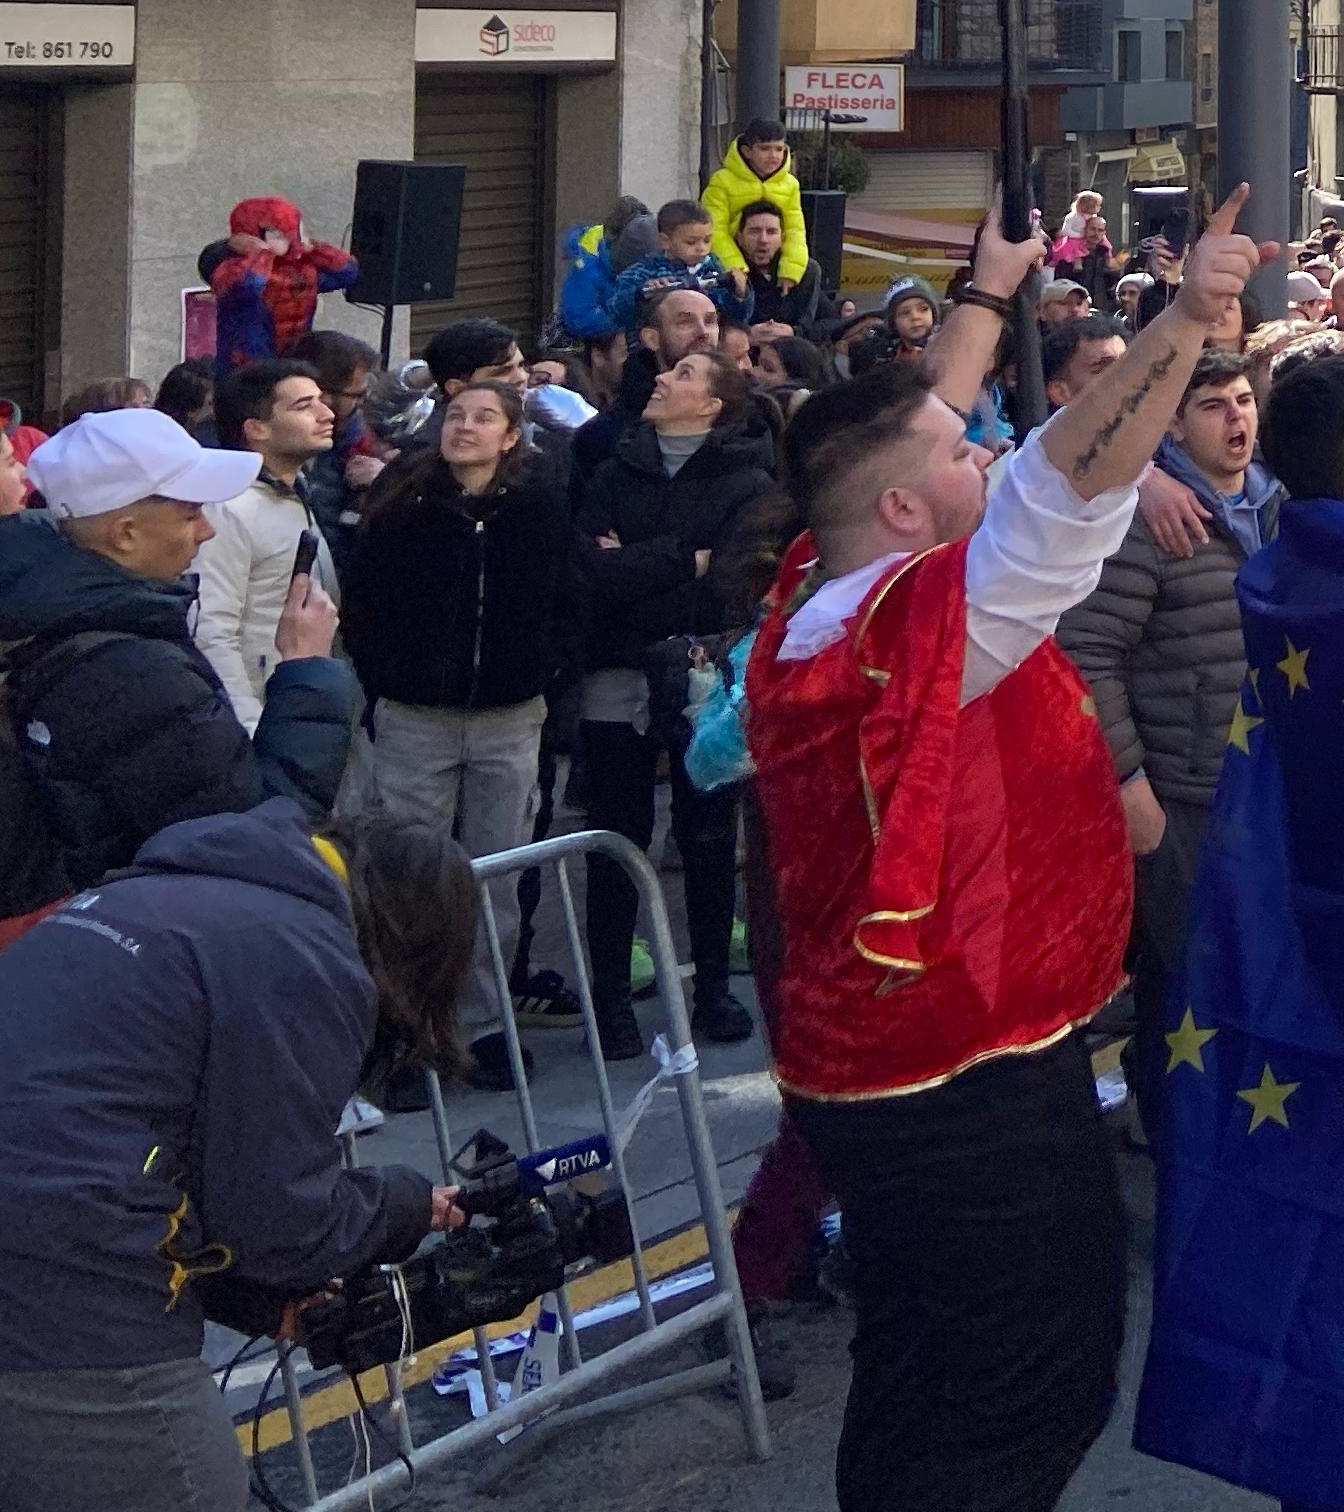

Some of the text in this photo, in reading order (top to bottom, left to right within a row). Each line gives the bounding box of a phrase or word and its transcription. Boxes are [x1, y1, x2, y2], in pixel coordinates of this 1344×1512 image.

[5, 41, 113, 58] Tel: 861 790
[807, 72, 884, 89] FLECA
[793, 93, 896, 110] Pastisseria
[558, 1150, 600, 1176] RTVA
